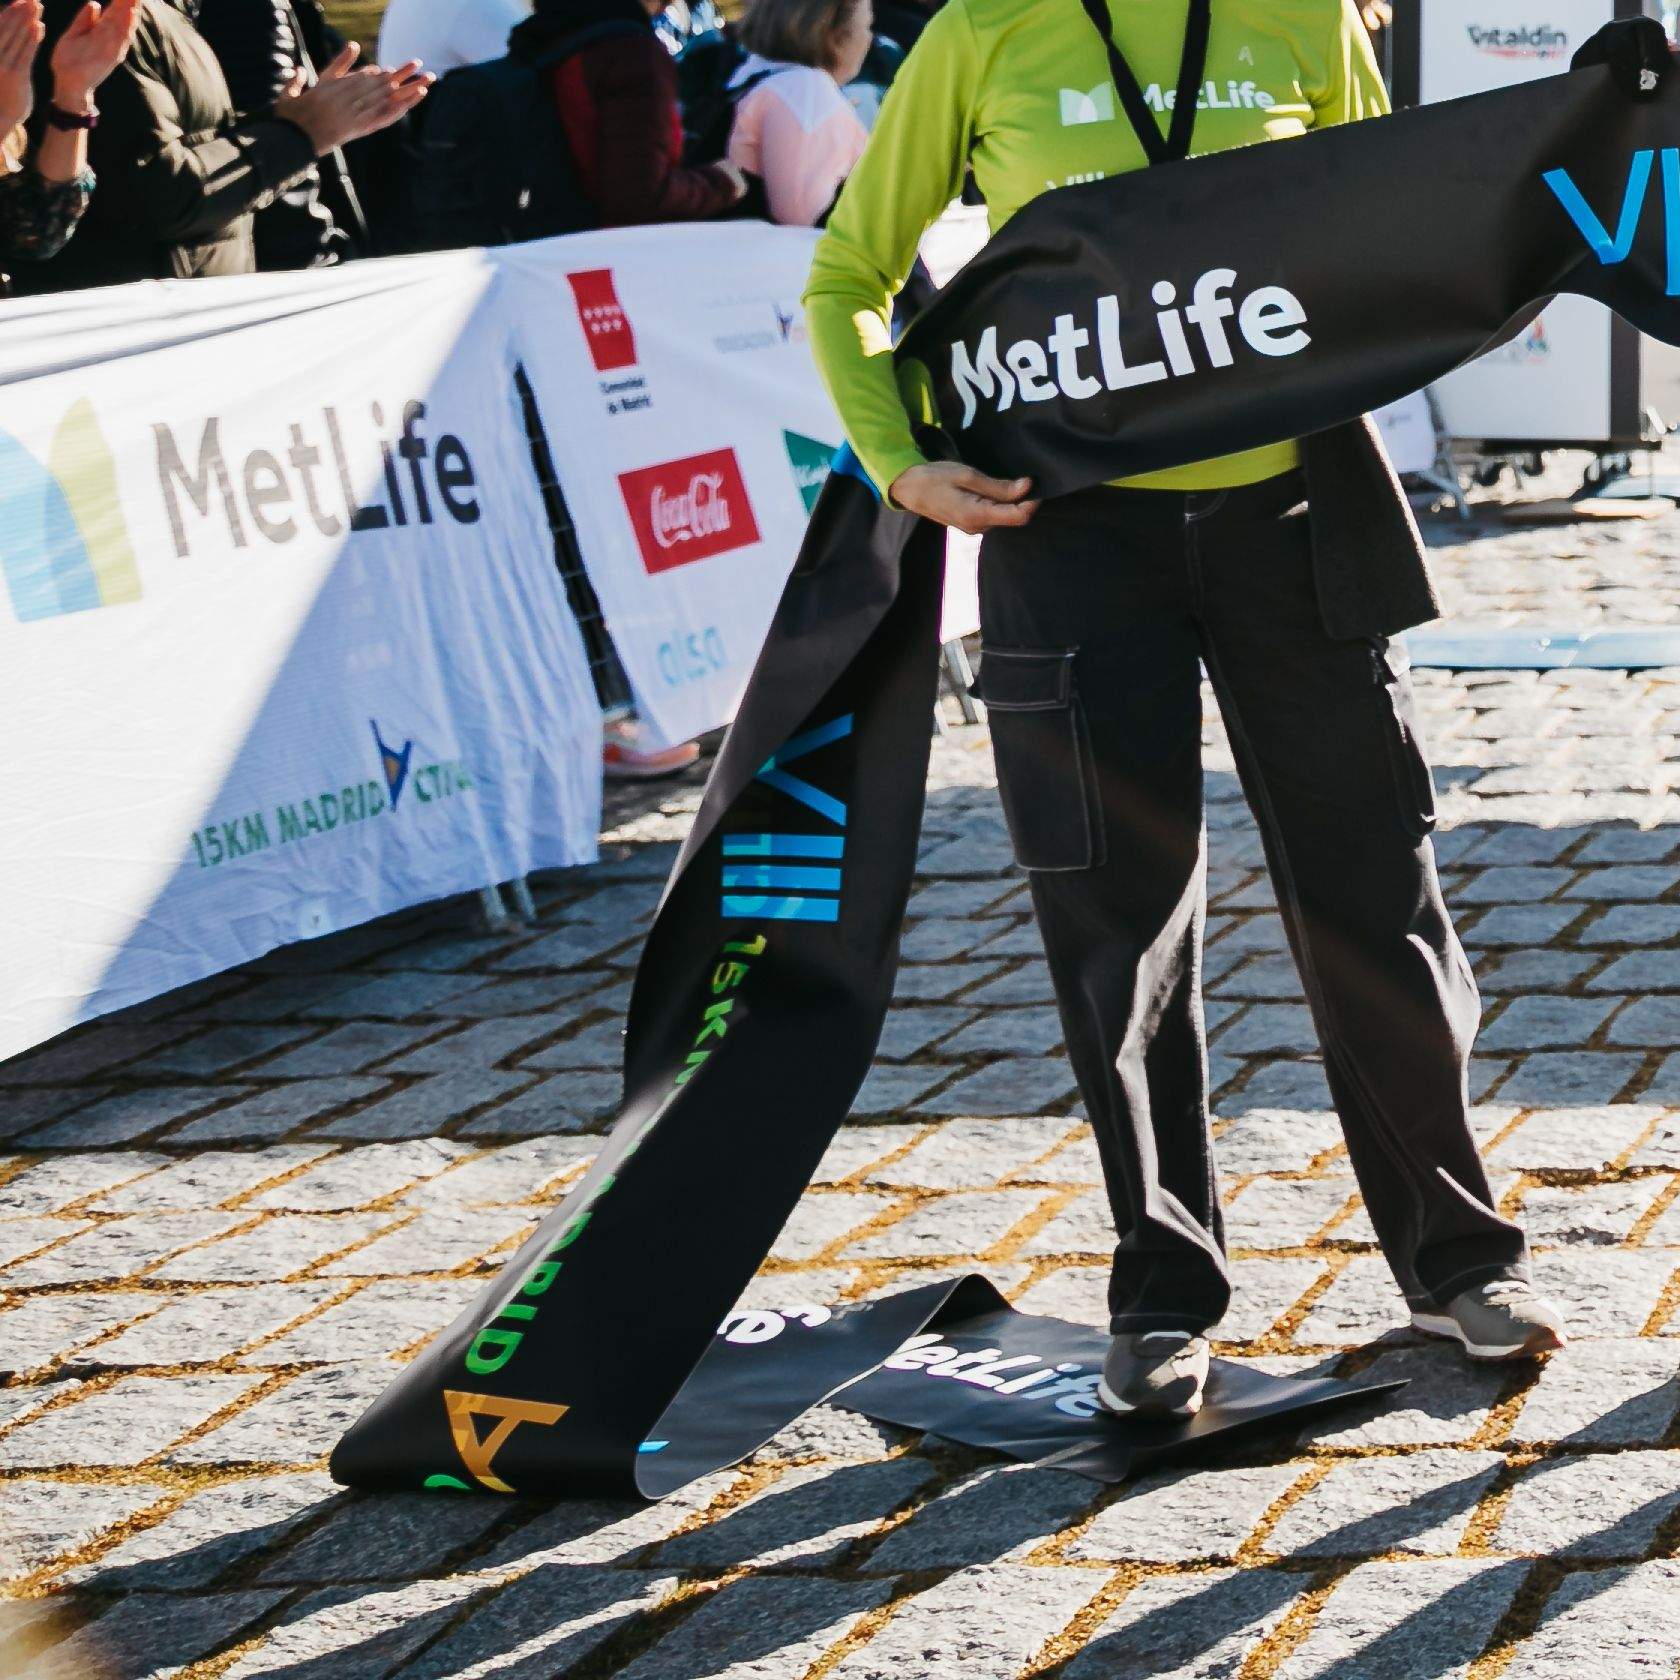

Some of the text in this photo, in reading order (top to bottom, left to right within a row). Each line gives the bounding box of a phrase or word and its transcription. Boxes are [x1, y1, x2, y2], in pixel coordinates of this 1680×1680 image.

[951, 267, 1312, 429] MetLife
[150, 400, 481, 557] MetLife
[657, 626, 727, 687] alsa
[191, 812, 270, 868] 15KM
[276, 780, 385, 844] MADRID
